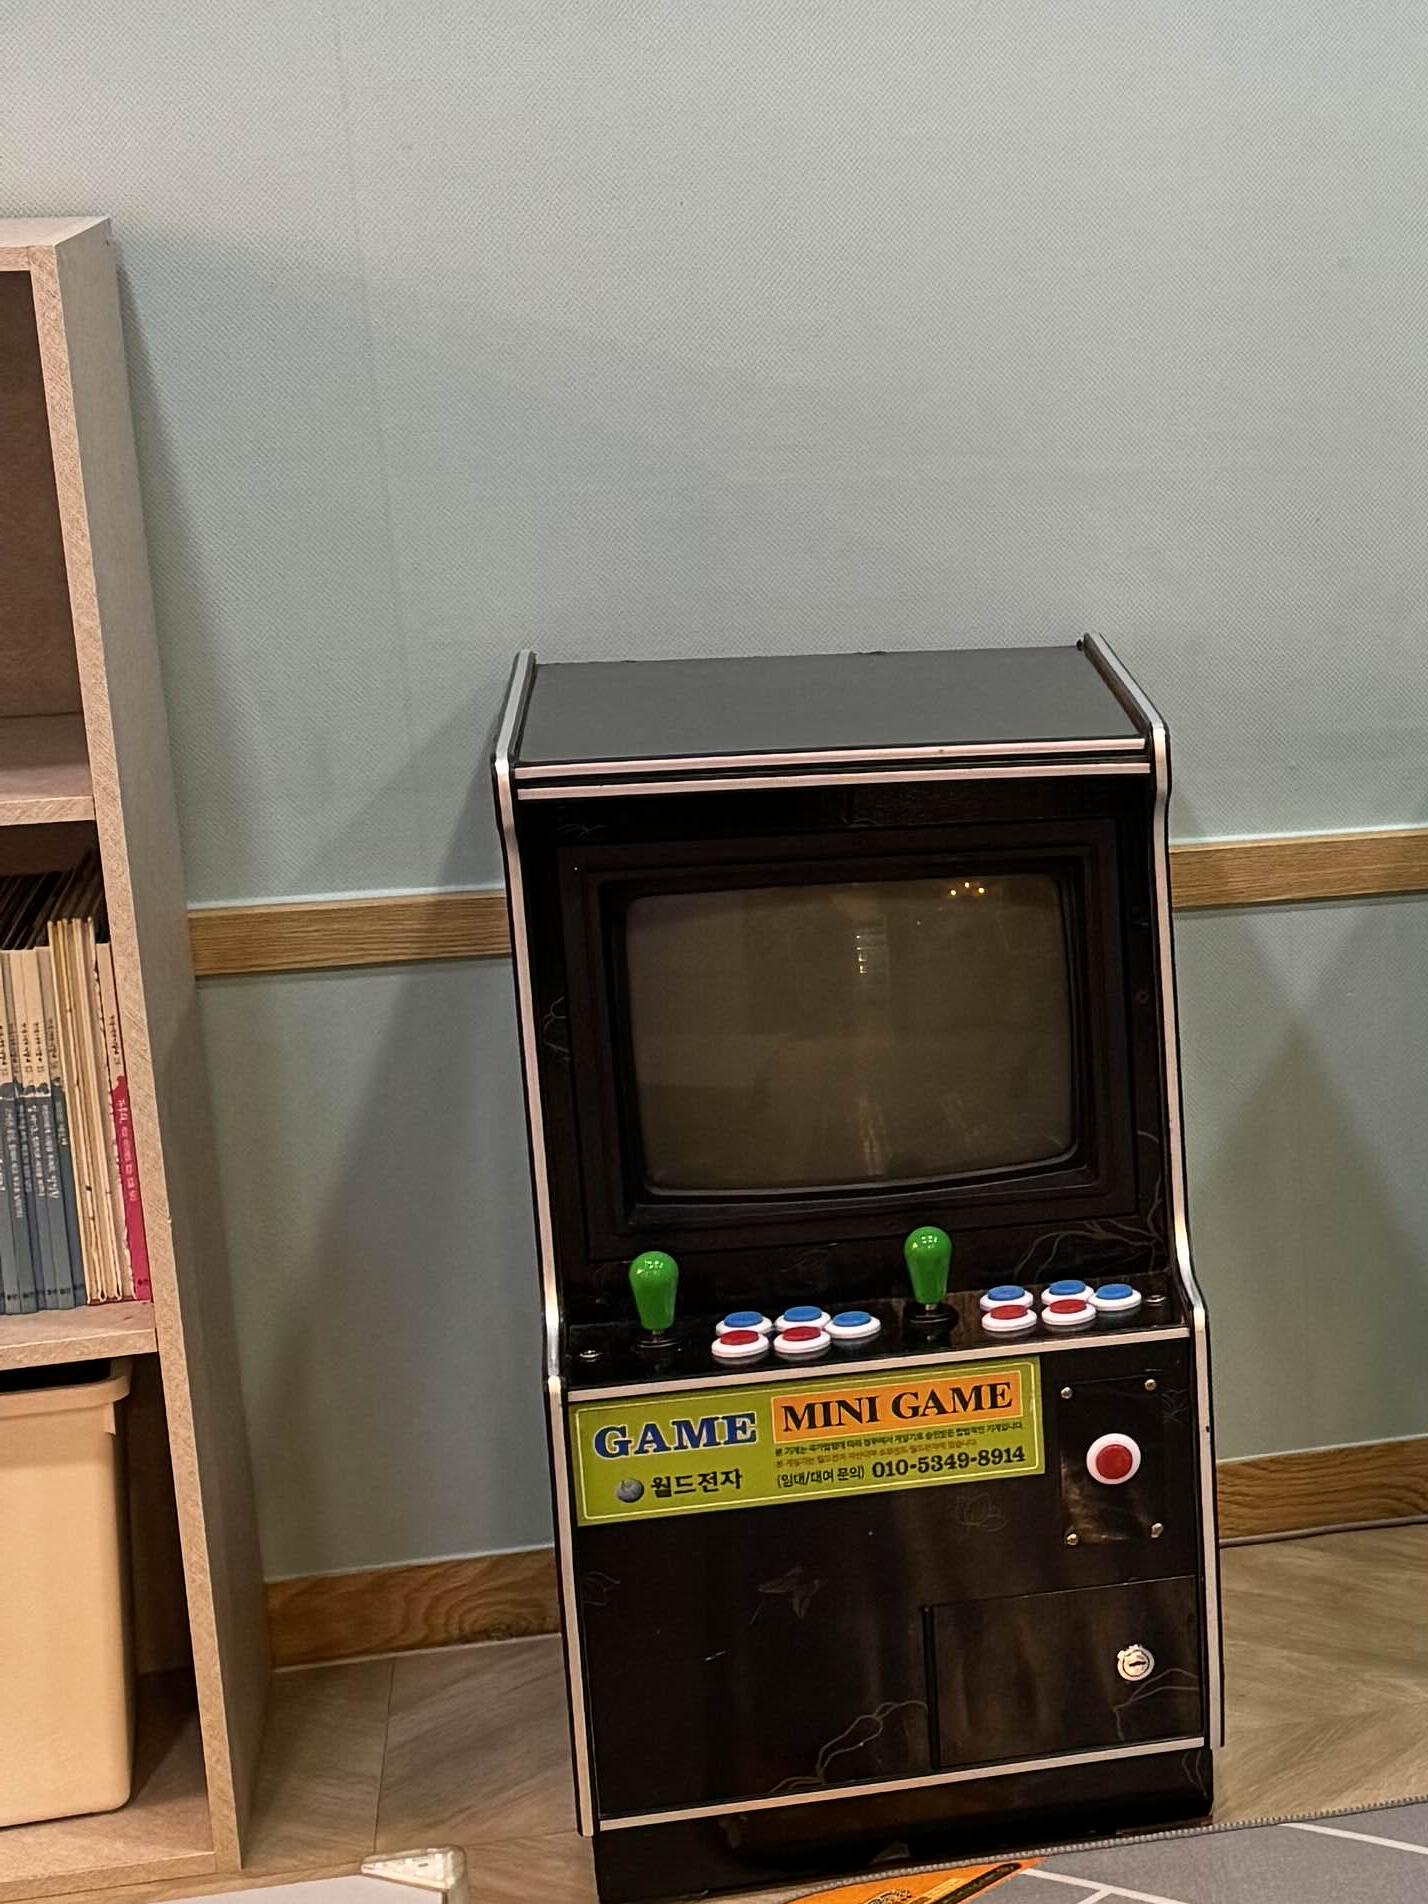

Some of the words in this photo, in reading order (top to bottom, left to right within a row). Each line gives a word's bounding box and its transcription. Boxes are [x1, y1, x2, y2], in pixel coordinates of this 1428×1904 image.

[782, 1396, 880, 1432] MINI
[891, 1382, 1013, 1419] GAME
[594, 1412, 757, 1459] GAME
[872, 1446, 1026, 1478] 010-5349-8914
[651, 1468, 742, 1497] 월드전자
